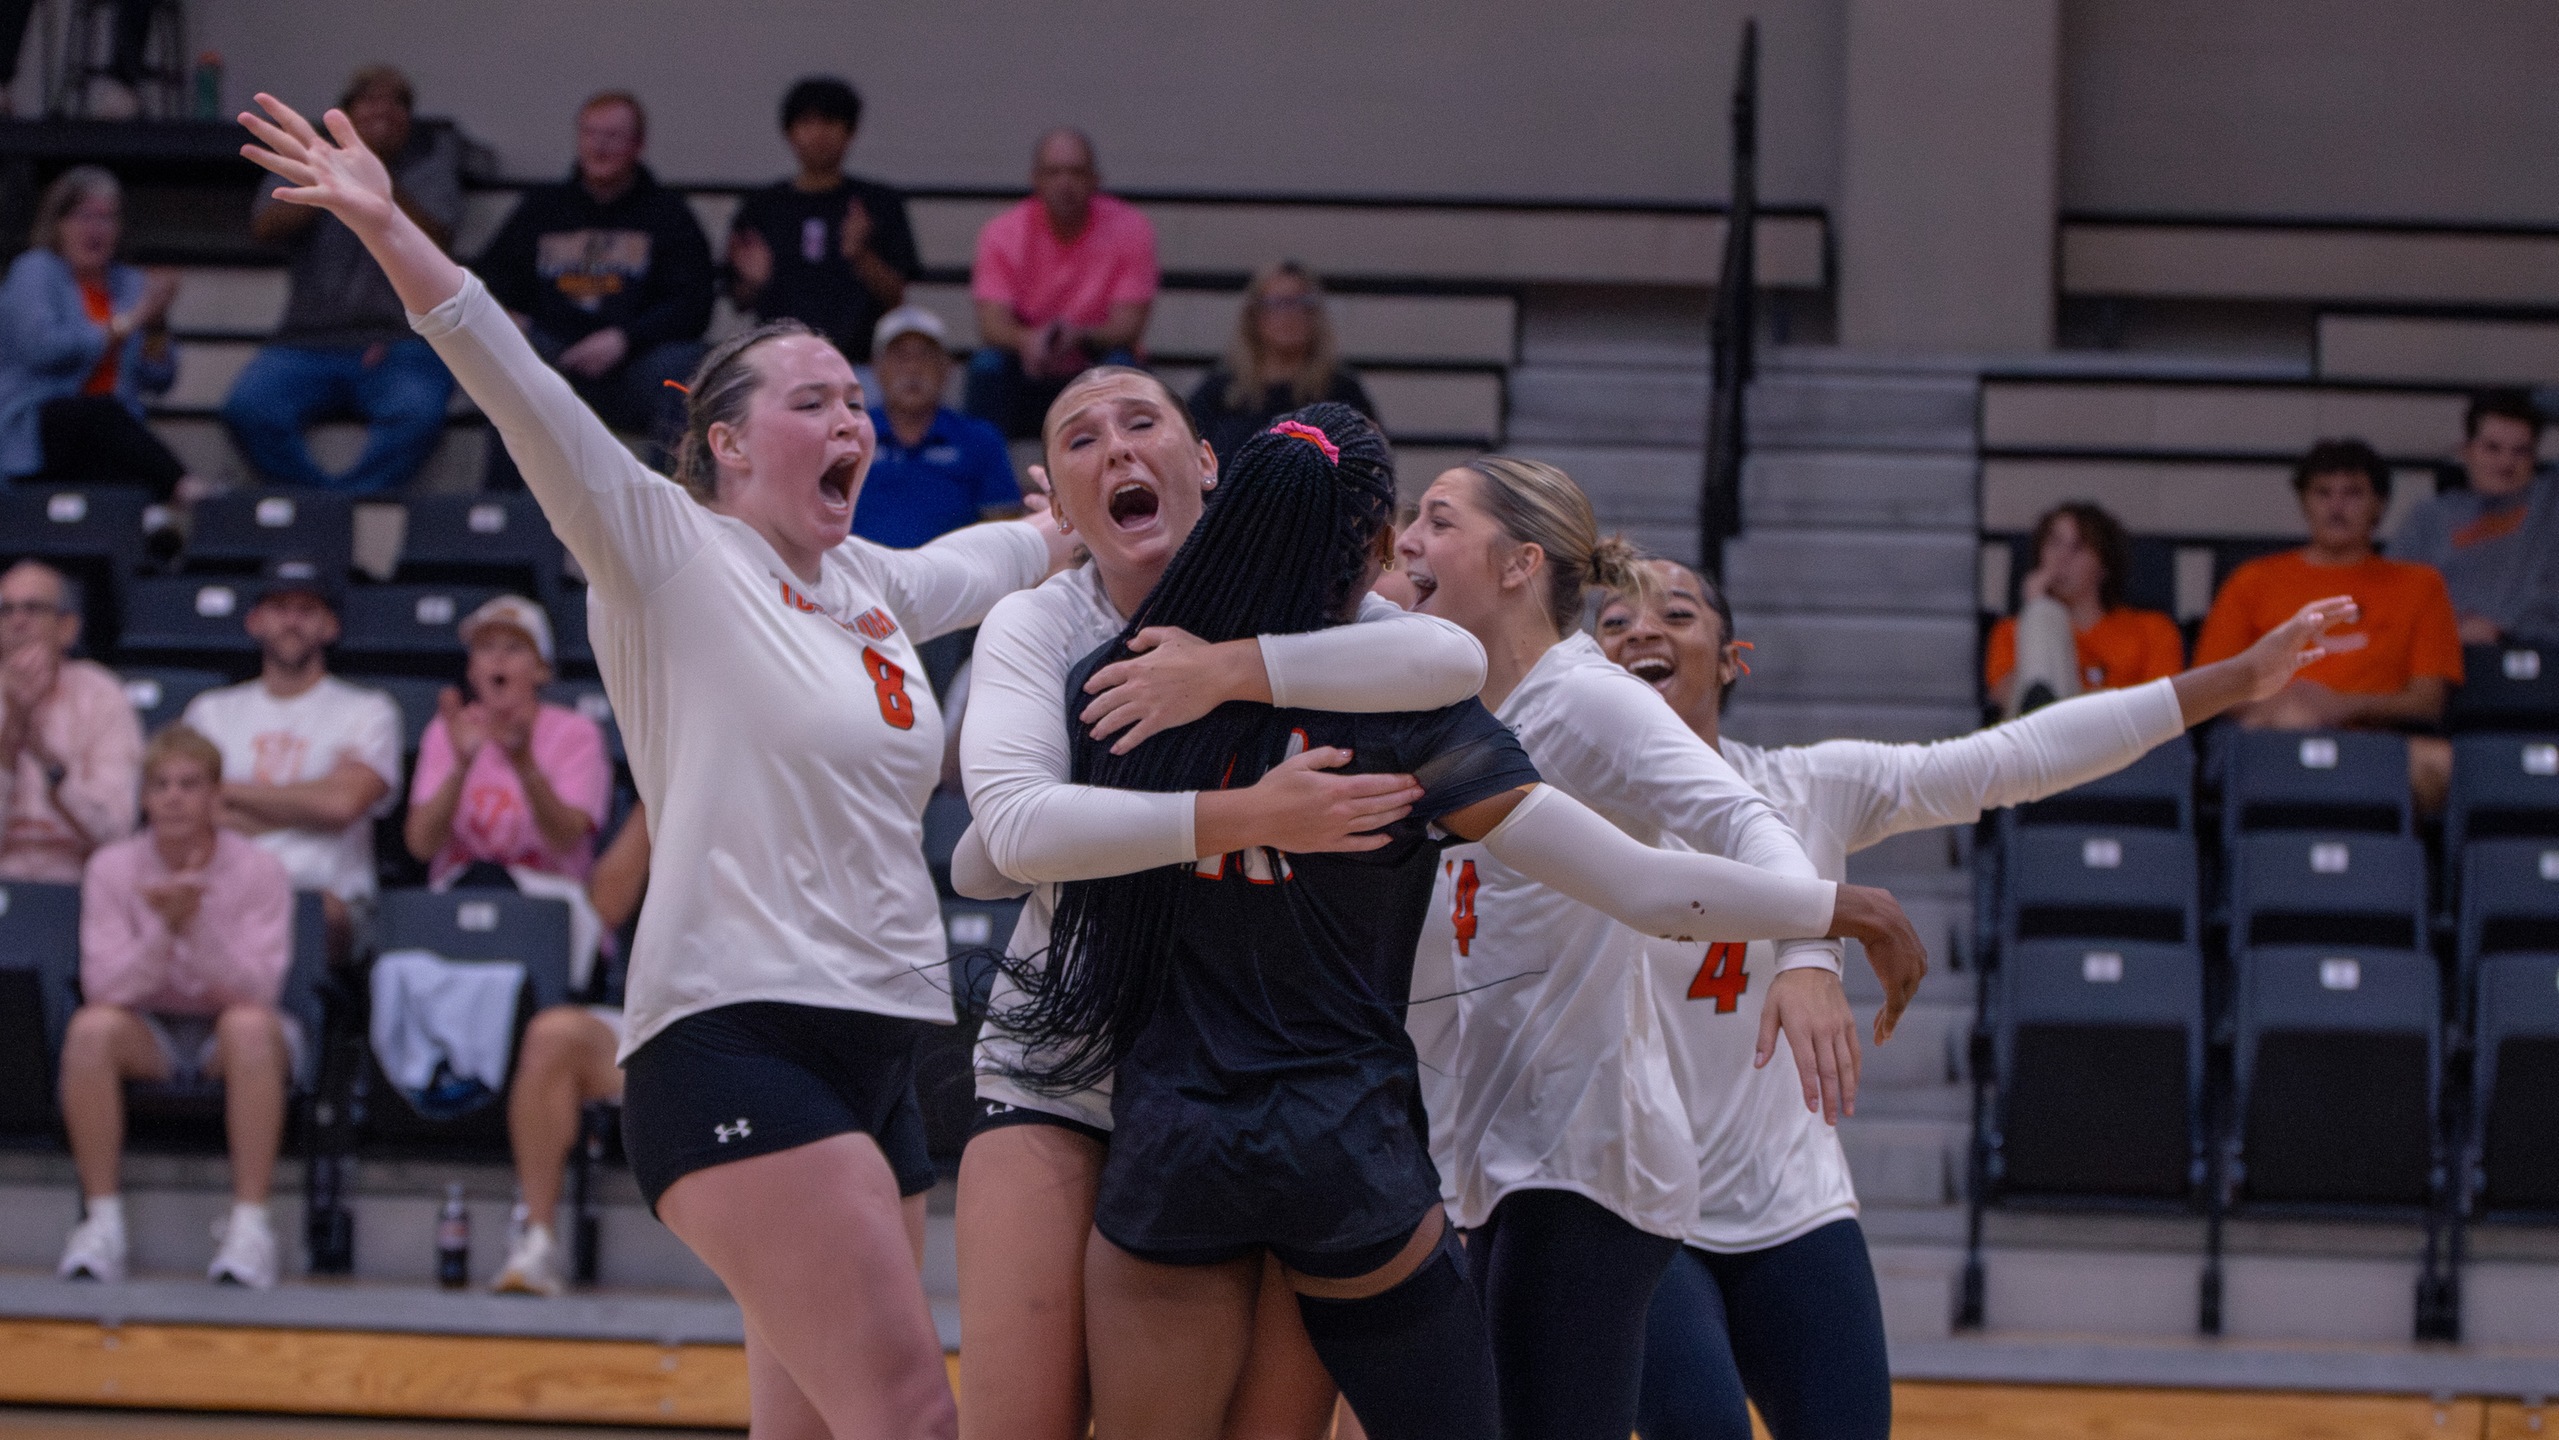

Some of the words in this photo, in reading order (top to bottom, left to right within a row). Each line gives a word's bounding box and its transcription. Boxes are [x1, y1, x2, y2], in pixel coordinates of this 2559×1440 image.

[861, 645, 915, 731] 8
[1445, 859, 1481, 957] 4
[1686, 941, 1750, 1015] 4
